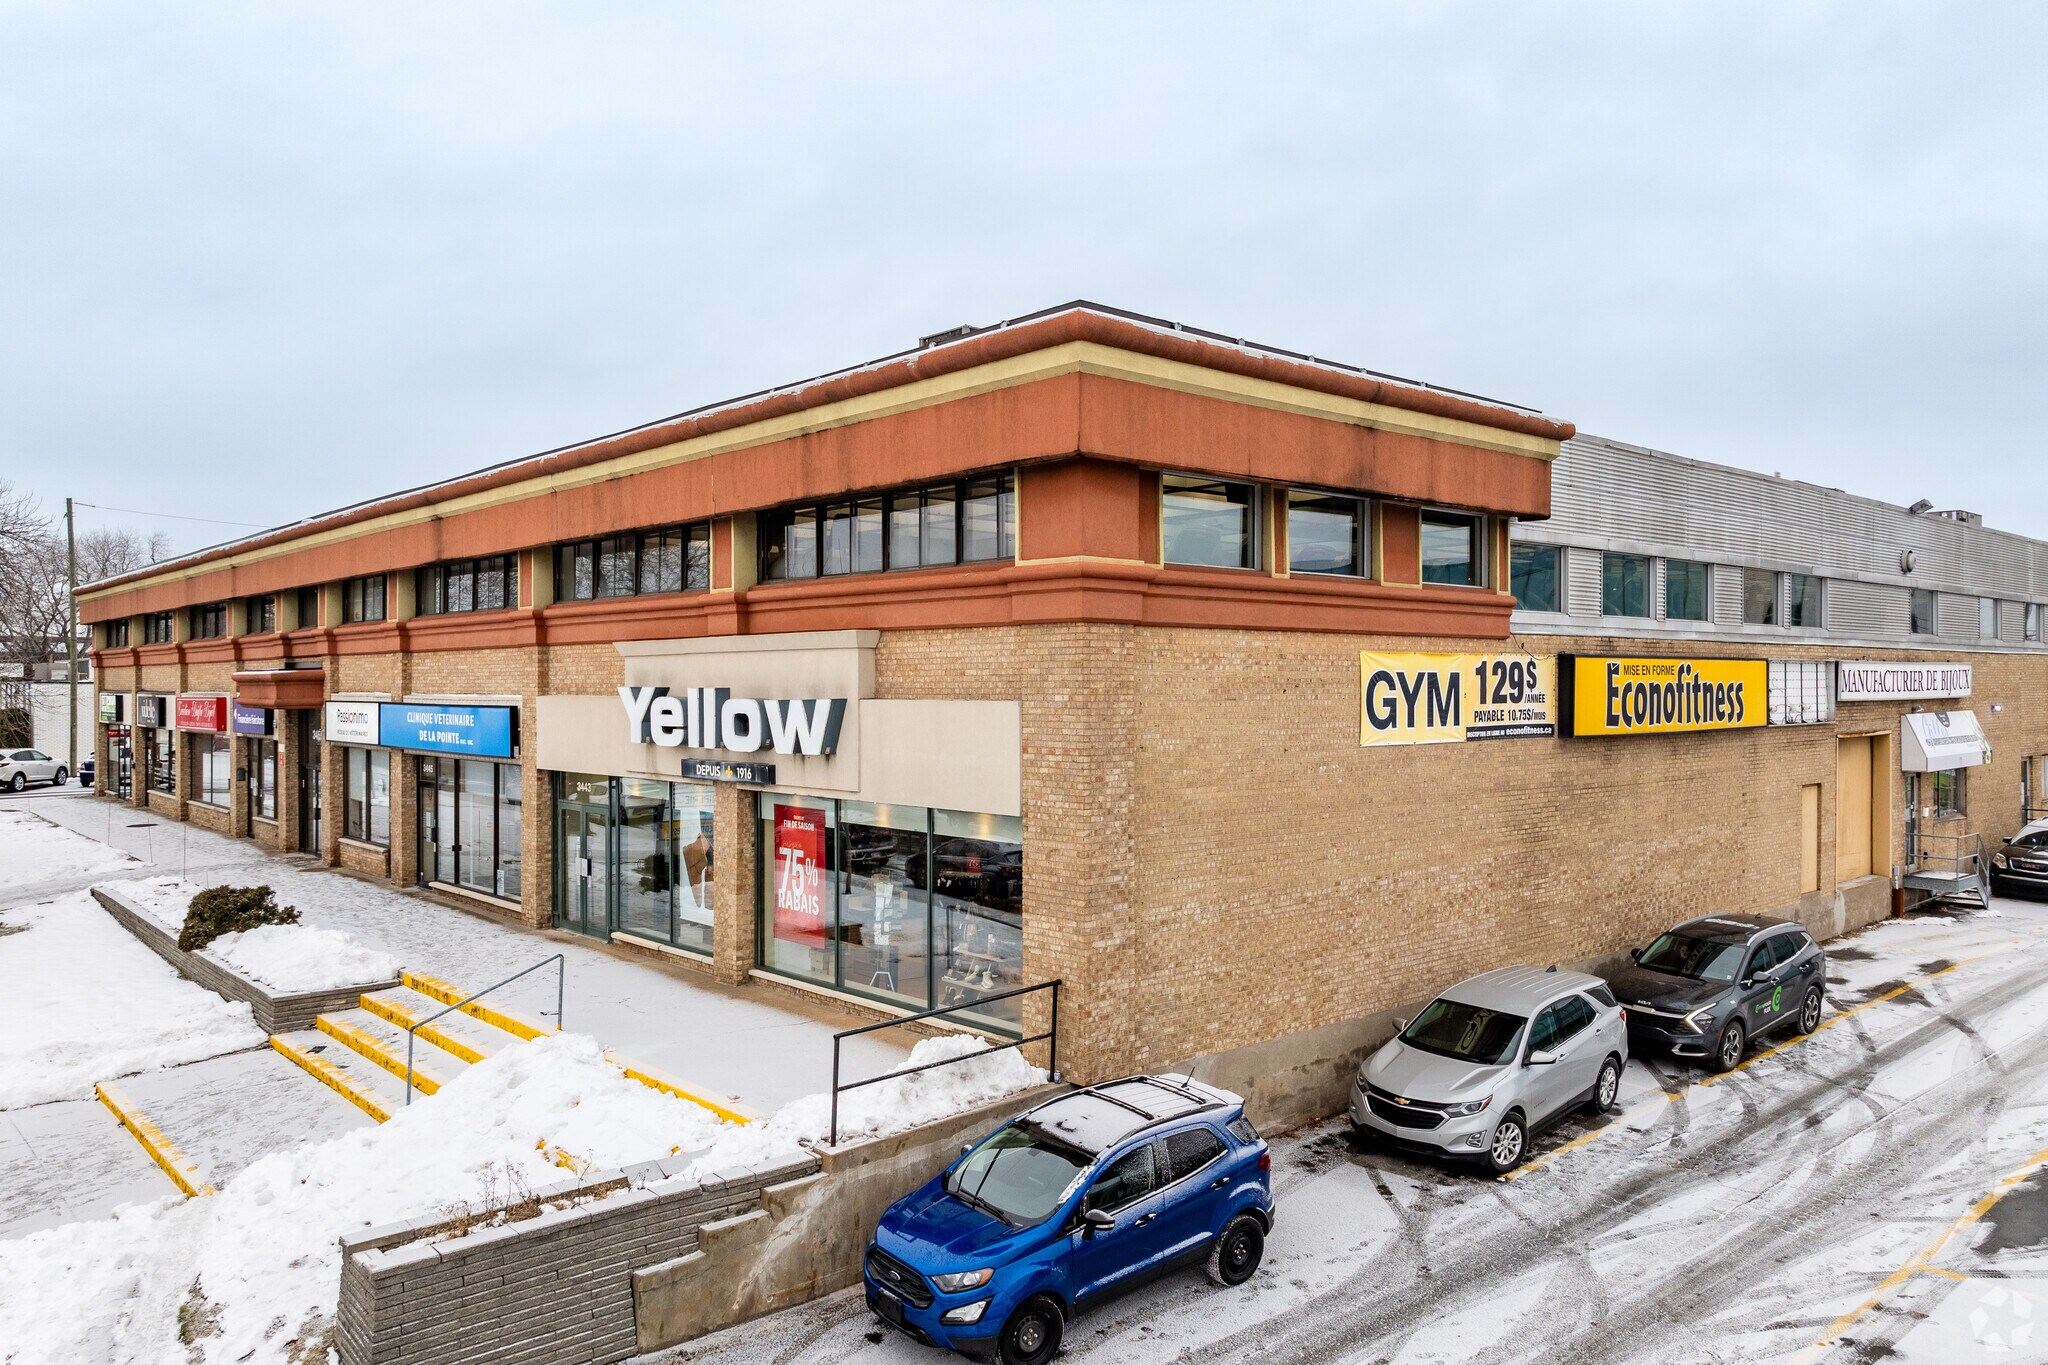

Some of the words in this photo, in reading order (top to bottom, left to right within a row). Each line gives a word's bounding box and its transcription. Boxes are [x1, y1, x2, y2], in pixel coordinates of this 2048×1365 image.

[1623, 664, 1640, 676] MISE
[1641, 665, 1651, 676] EN
[1652, 665, 1675, 676] FORME
[1475, 658, 1537, 705] 129$
[1841, 669, 1924, 693] MANUFACTURIER
[1926, 670, 1937, 691] DE
[1941, 669, 1970, 695] BIJOUX
[1366, 670, 1460, 730] GYM
[336, 708, 369, 724] Passionimo
[407, 712, 433, 725] CLINIQUE
[617, 686, 847, 756] Yellow
[1474, 710, 1504, 722] PAYABLE
[419, 730, 427, 741] DE
[428, 730, 436, 742] LA
[437, 731, 459, 744] POINTE
[1506, 726, 1552, 735] econofitness.ca
[423, 764, 433, 772] 3445
[696, 764, 721, 777] DEPUIS
[736, 766, 752, 779] 1916
[576, 782, 592, 793] 3443
[783, 819, 791, 828] FIN
[791, 820, 799, 830] DE
[798, 821, 815, 832] SAISON
[779, 847, 818, 897] 75%
[778, 888, 820, 916] RABAIS
